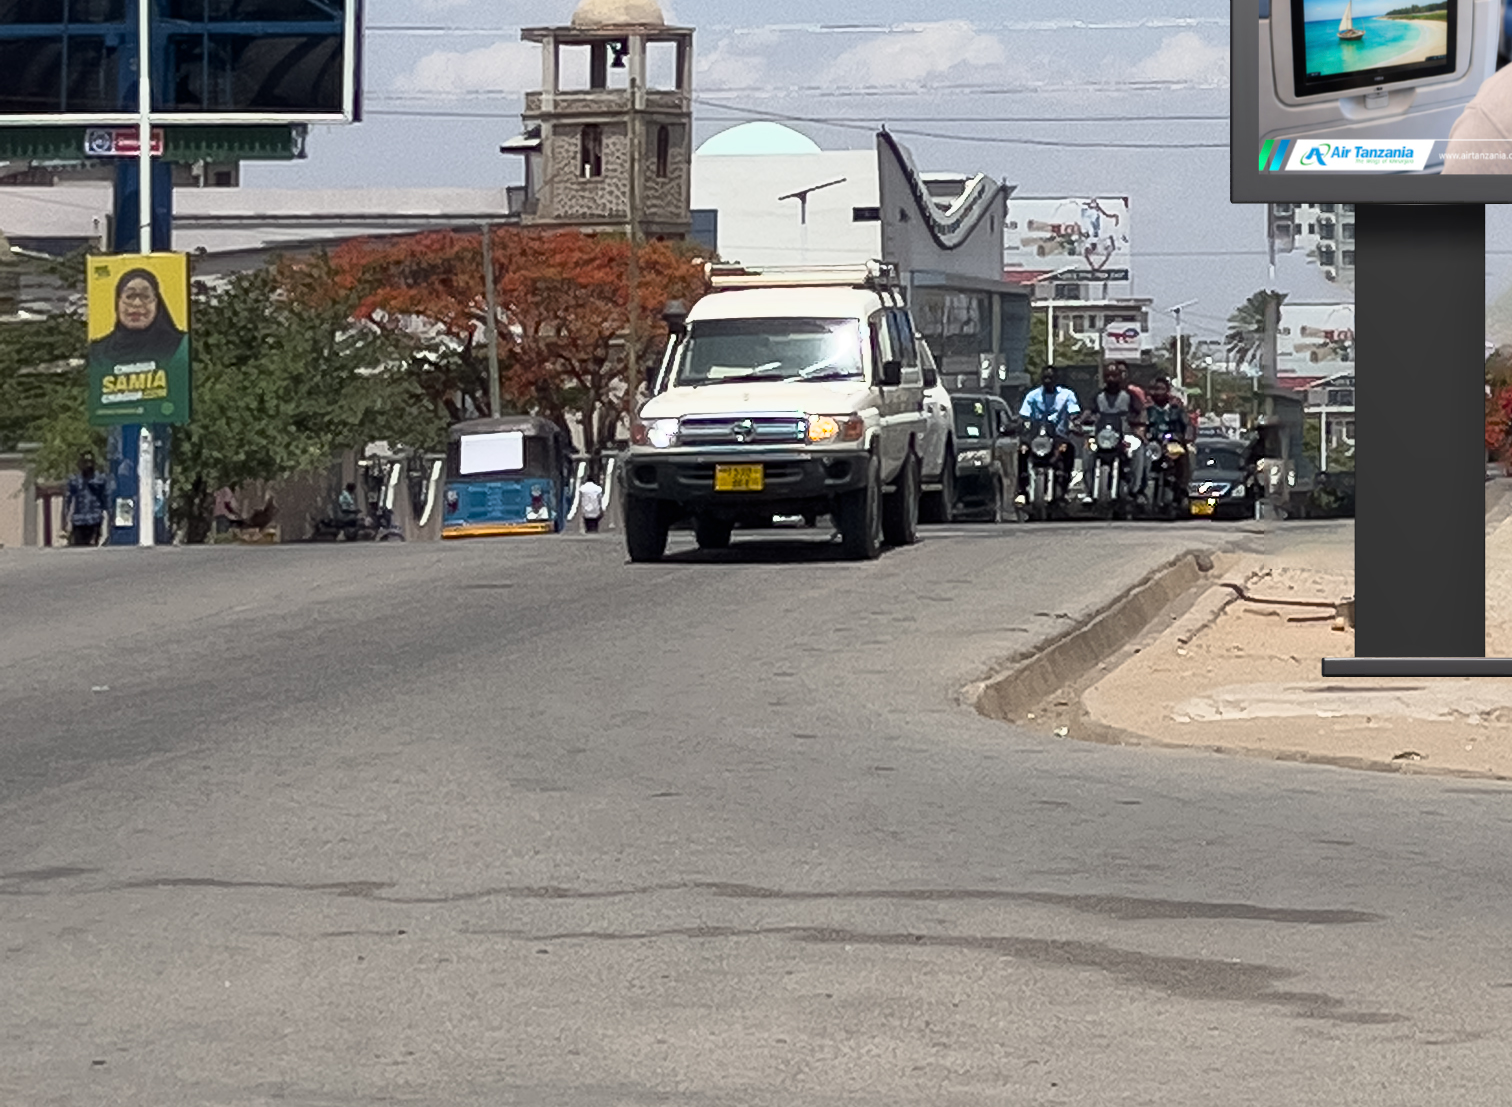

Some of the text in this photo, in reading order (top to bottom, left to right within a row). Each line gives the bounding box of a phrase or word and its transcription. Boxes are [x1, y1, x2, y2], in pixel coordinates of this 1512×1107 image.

[1330, 146, 1414, 159] Air Tanzania
[102, 369, 166, 393] SAMIA
